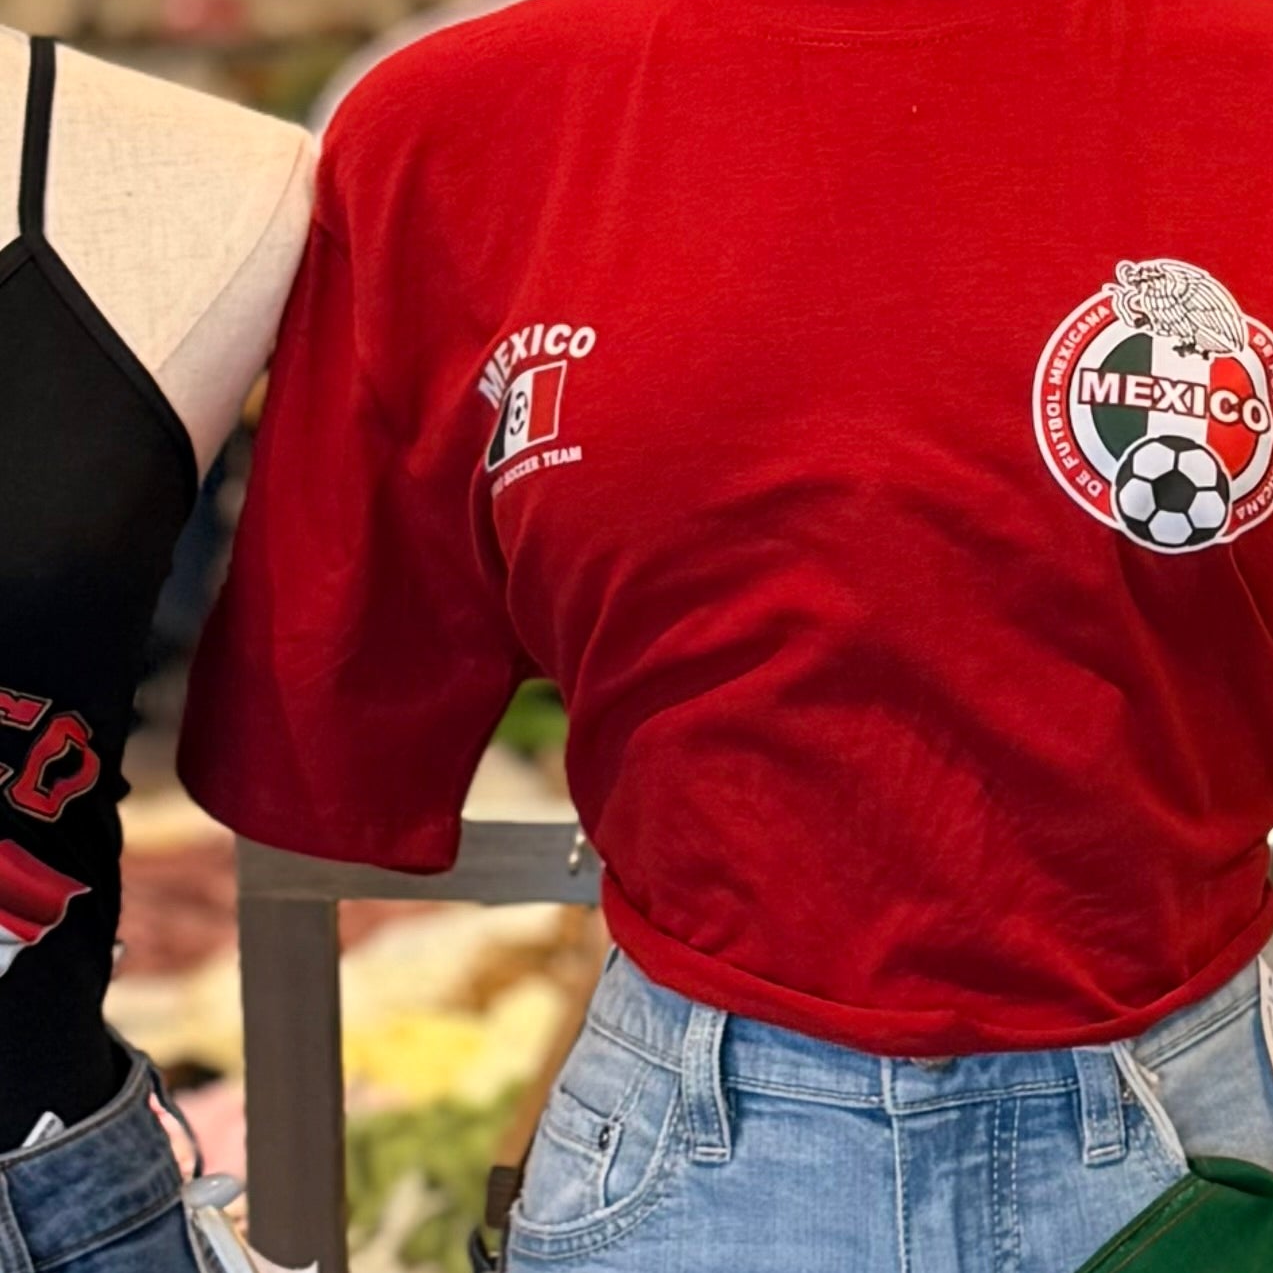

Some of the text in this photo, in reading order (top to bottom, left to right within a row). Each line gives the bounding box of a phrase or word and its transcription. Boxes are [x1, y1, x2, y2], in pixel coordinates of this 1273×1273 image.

[477, 323, 596, 410] MEXICO
[1046, 304, 1111, 498] DE FUTBOL MEXICANA
[1079, 369, 1271, 433] MEXICO
[542, 445, 583, 468] TEAM
